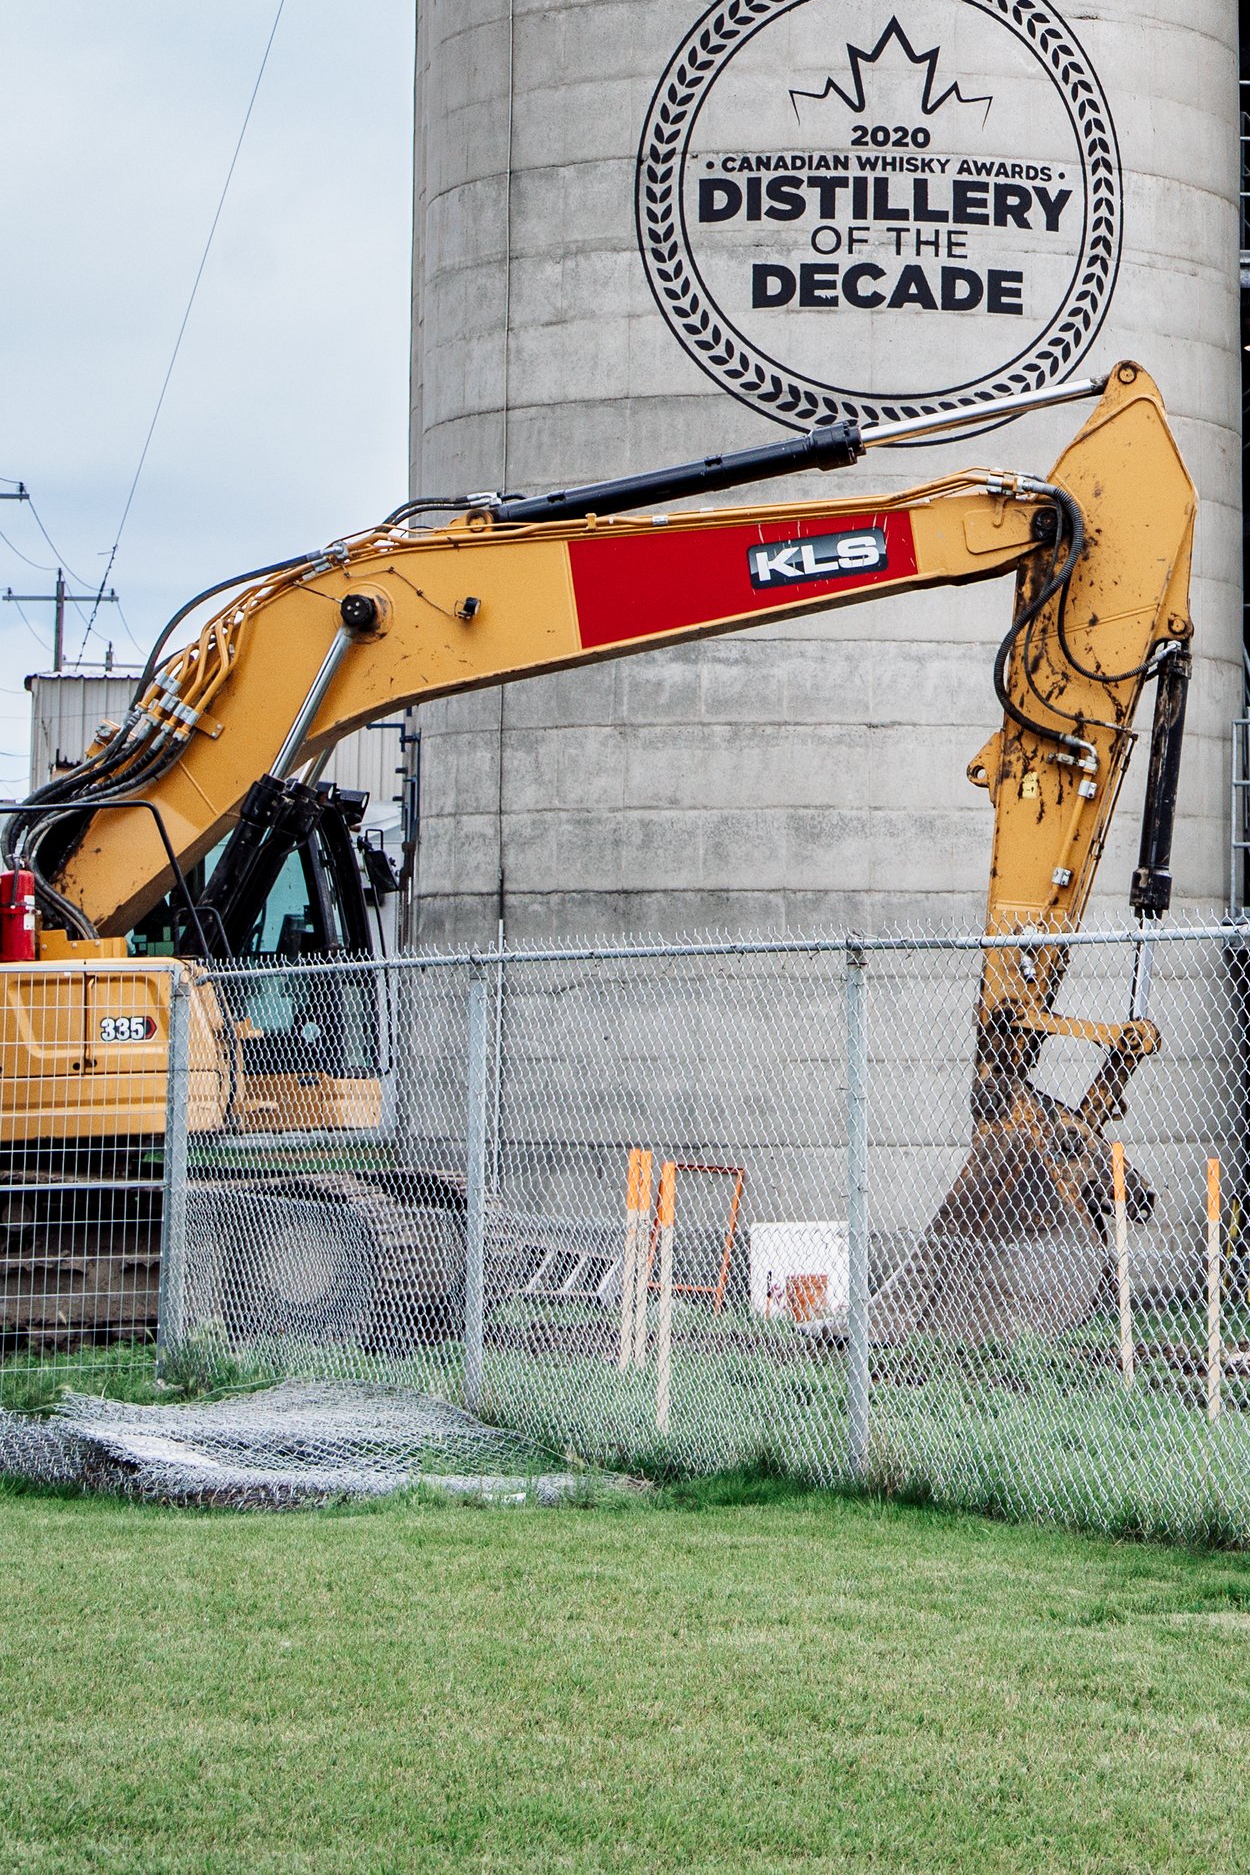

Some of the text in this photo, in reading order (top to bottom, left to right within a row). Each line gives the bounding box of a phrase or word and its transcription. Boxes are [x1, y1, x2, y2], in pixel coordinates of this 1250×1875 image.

[850, 124, 931, 148] 2020
[722, 154, 1053, 183] CANADIAN WHISKY AWARDS
[698, 175, 1073, 233] DISTILLERY
[811, 225, 969, 259] OF THE
[751, 262, 1025, 316] DECADE
[755, 535, 881, 582] KLS
[100, 1017, 145, 1041] 335
